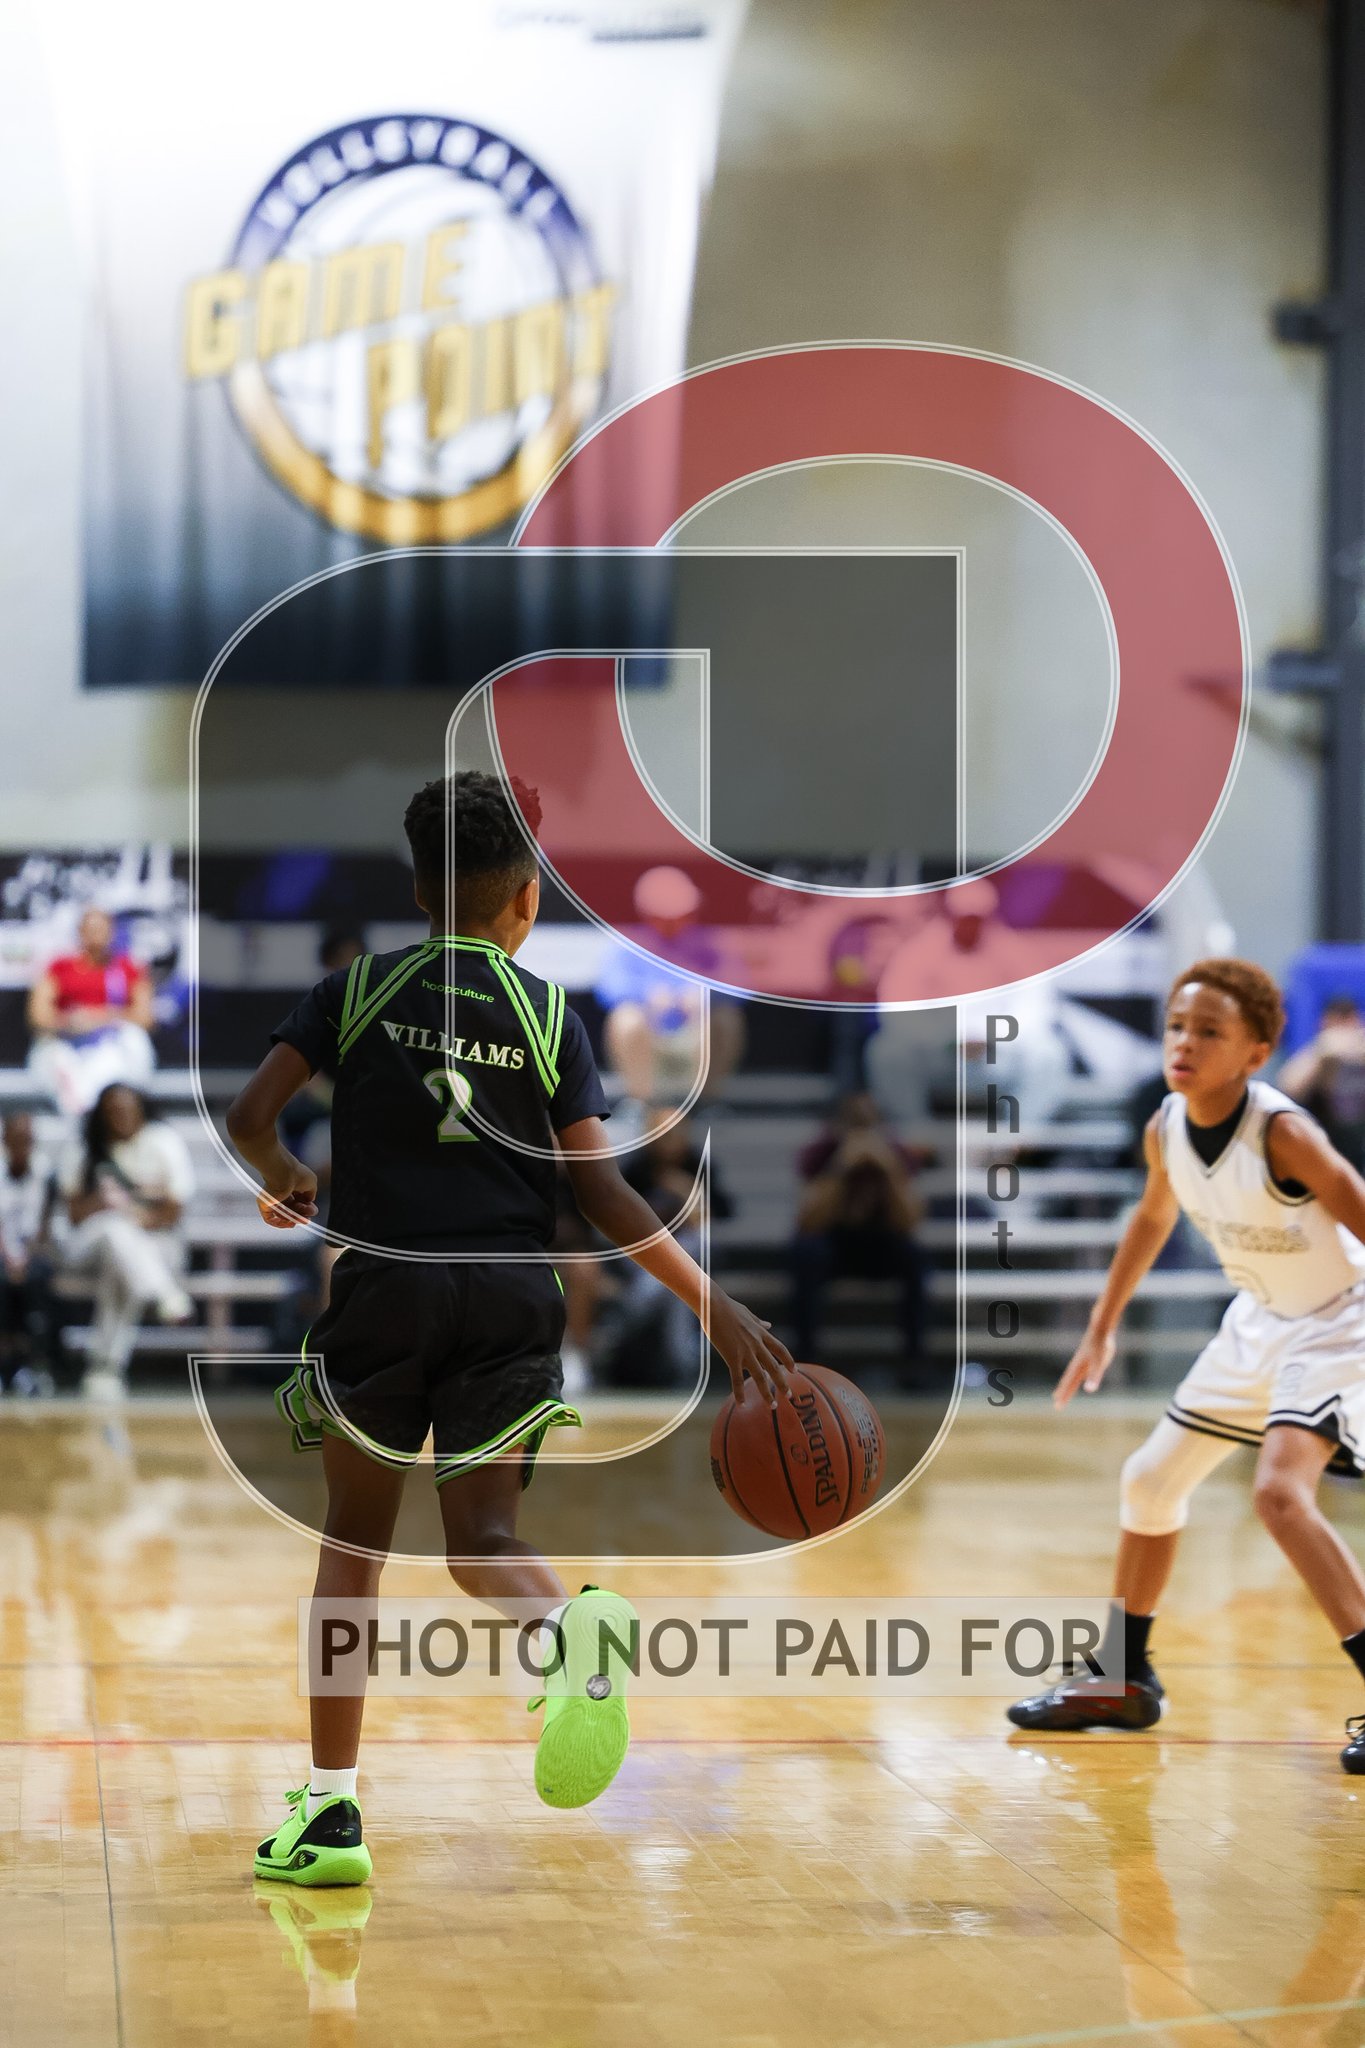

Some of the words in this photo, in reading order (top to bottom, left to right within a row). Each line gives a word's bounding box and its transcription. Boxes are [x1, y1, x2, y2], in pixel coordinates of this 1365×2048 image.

[183, 219, 472, 381] GAME
[364, 283, 622, 470] POINT
[421, 978, 495, 1003] hoopculture
[380, 1020, 525, 1071] WILLIAMS
[422, 1067, 481, 1143] 2
[788, 1388, 841, 1509] SPALDING
[841, 1389, 874, 1494] PRECS
